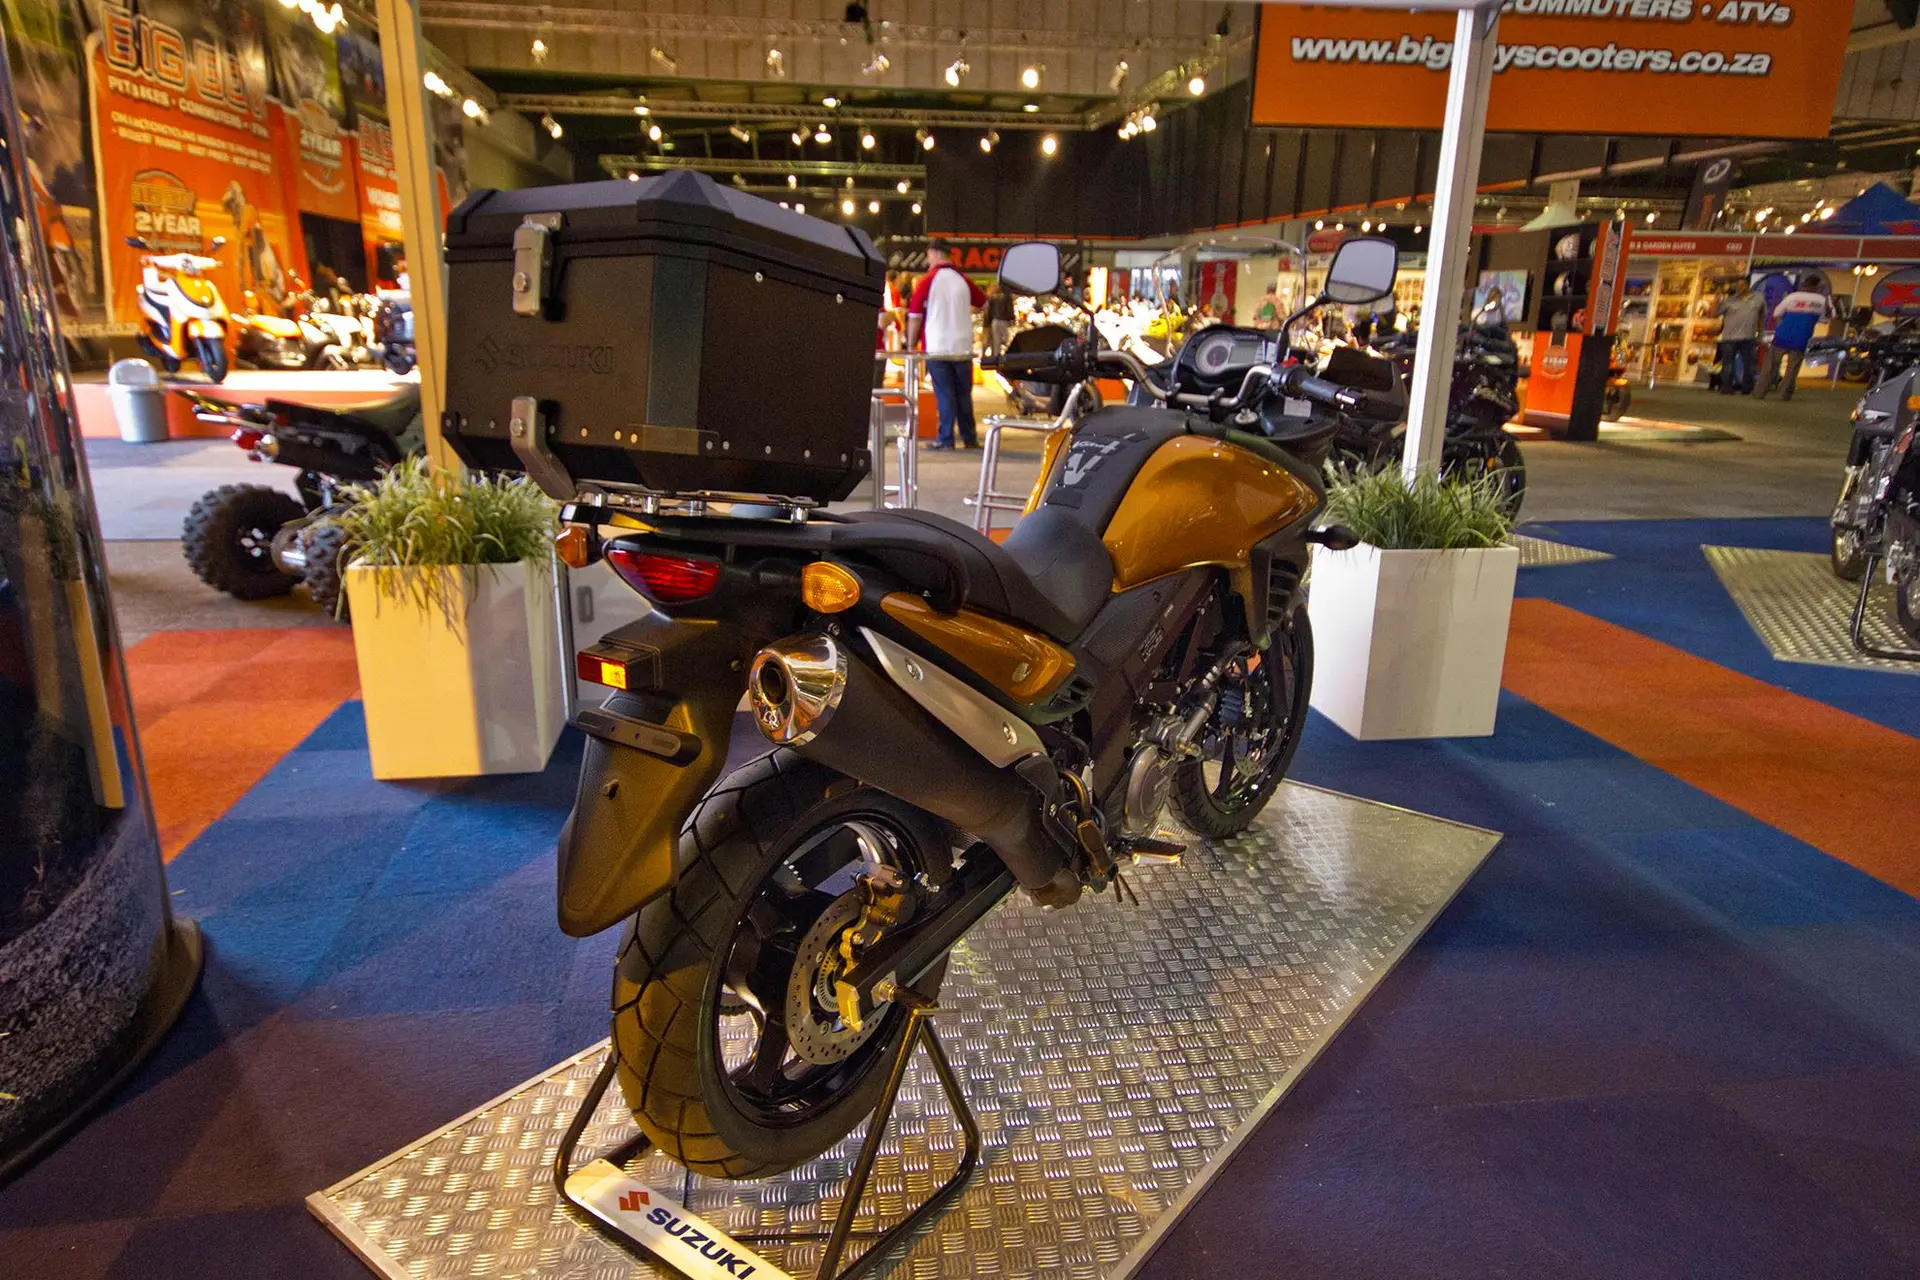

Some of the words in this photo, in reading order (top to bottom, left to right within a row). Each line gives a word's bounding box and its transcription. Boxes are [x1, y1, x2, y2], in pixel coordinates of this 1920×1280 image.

[1716, 1, 1791, 24] ATVs
[1291, 35, 1771, 75] www.bigyscooters.co.za
[951, 247, 1007, 270] RAC
[646, 1207, 757, 1280] SUZUKI
